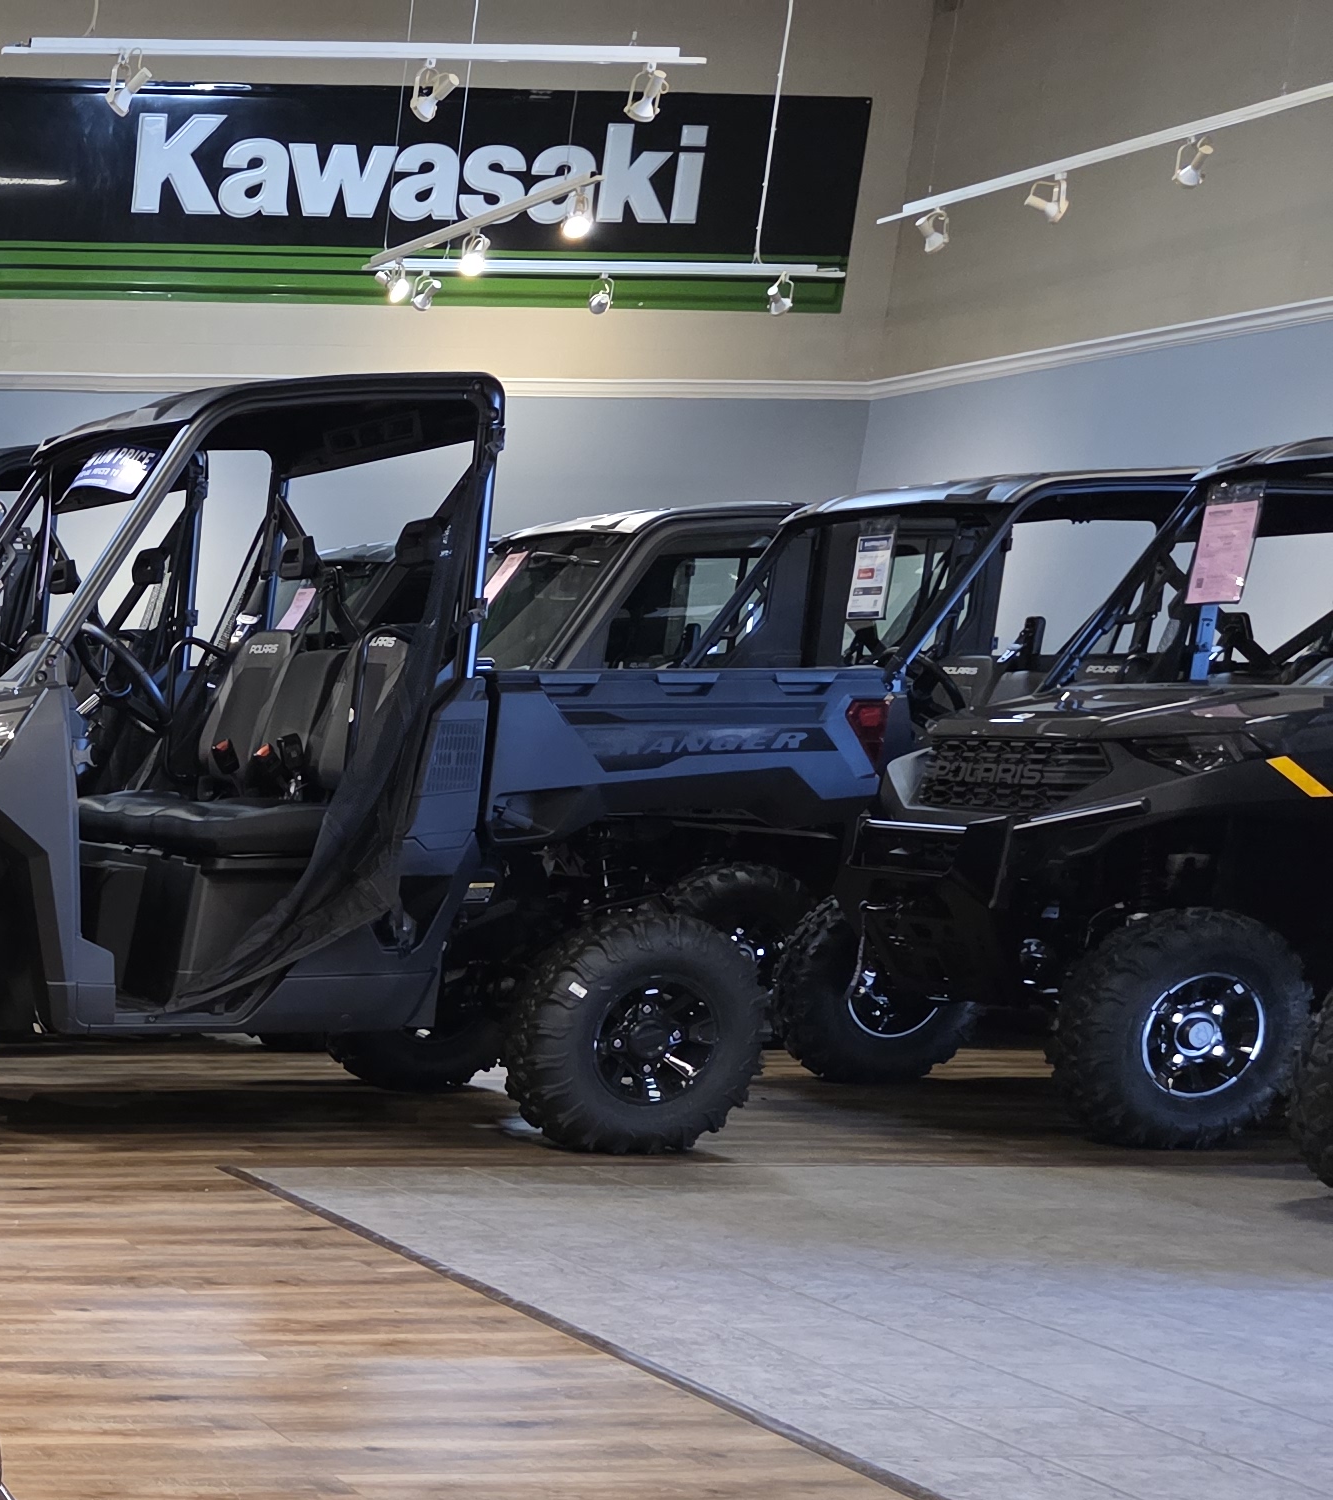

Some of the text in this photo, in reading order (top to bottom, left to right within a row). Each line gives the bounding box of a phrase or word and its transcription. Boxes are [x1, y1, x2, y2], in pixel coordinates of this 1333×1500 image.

[131, 113, 709, 225] Kawasaki
[249, 643, 279, 654] POLARIS
[934, 760, 1044, 785] POLARIS
